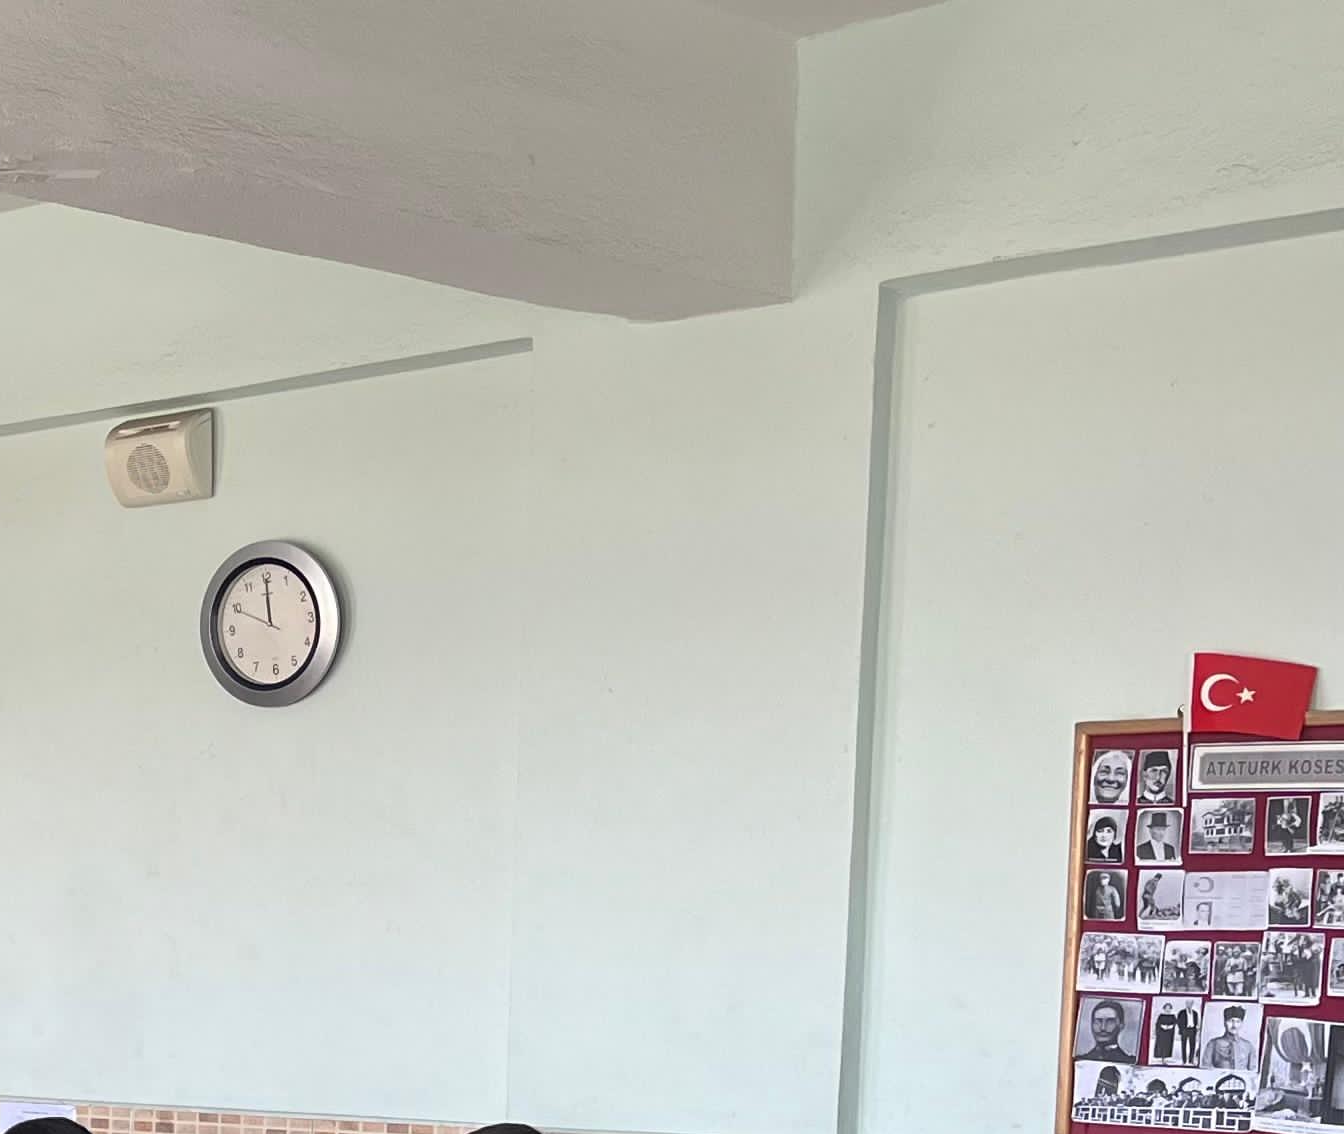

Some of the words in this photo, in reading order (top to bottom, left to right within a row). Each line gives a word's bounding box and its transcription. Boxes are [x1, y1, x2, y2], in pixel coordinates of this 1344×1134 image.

[284, 576, 288, 585] 1
[245, 582, 253, 592] 11
[299, 592, 306, 602] 2
[233, 603, 241, 614] 10
[308, 612, 314, 623] 3
[229, 625, 235, 636] 9
[304, 638, 310, 647] 4
[238, 648, 243, 658] 8
[291, 656, 297, 666] 5
[253, 662, 259, 672] 7
[273, 664, 279, 675] 6
